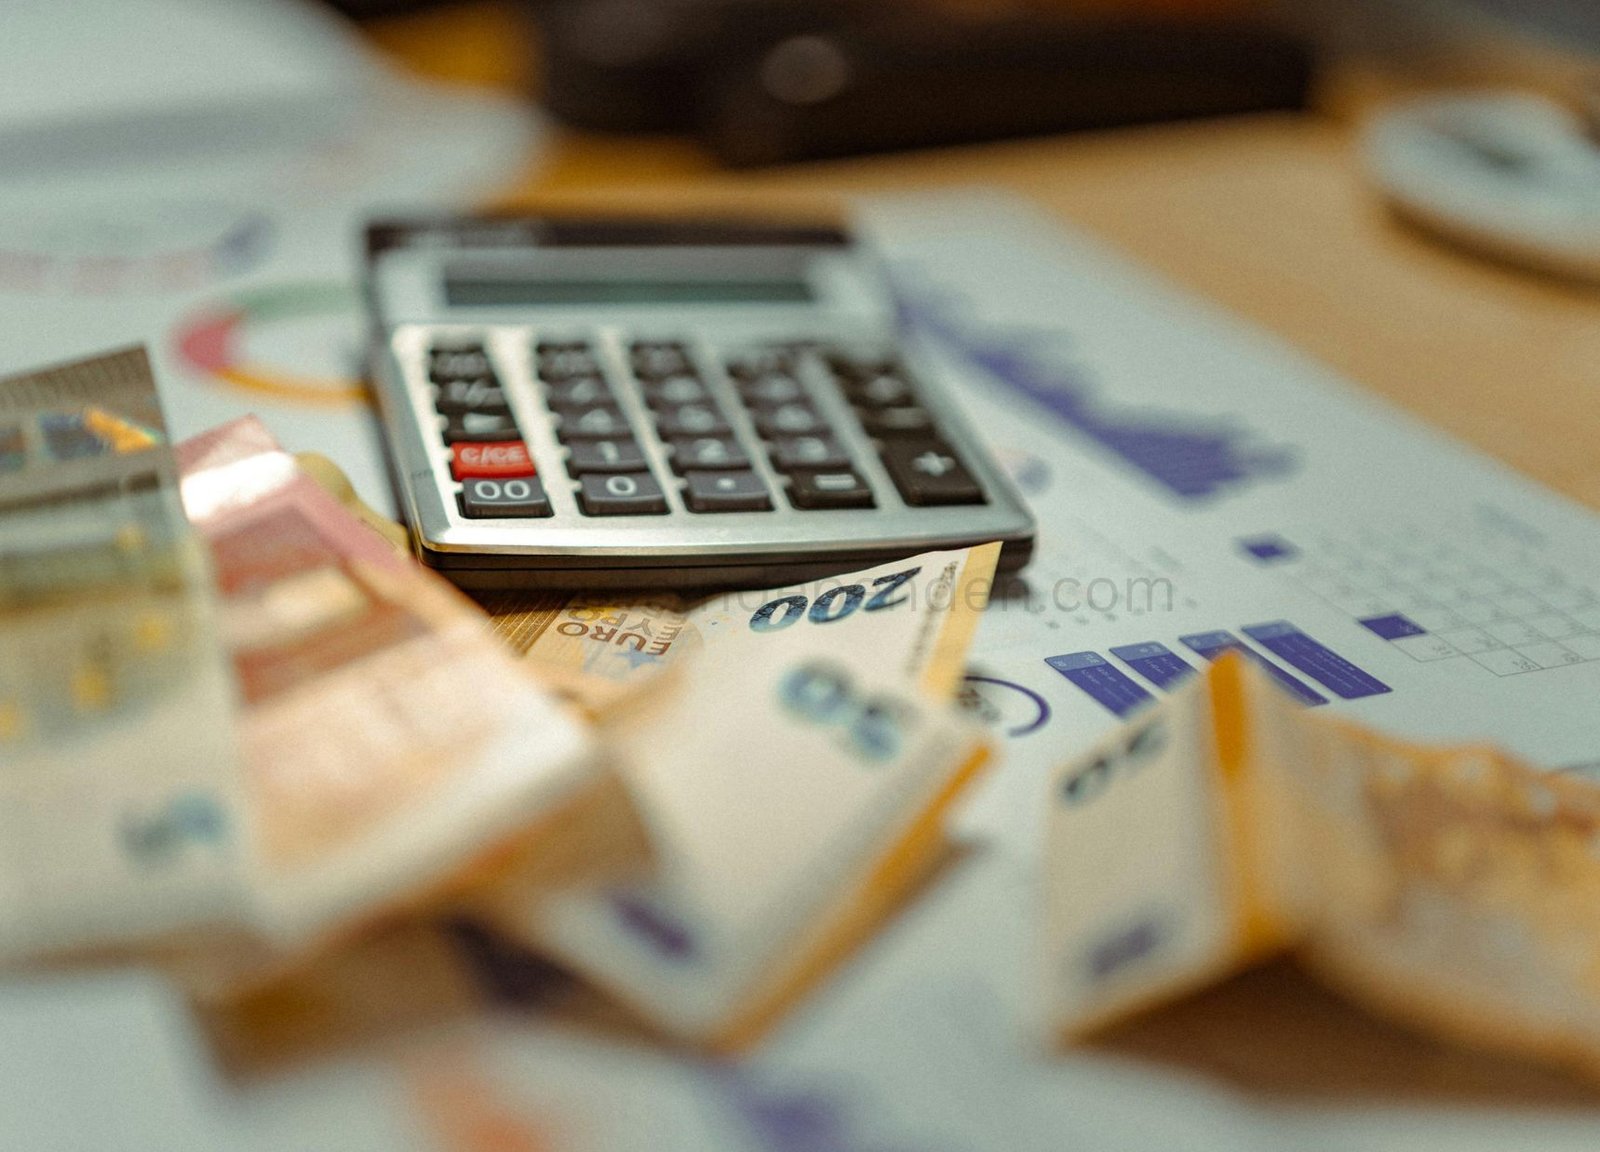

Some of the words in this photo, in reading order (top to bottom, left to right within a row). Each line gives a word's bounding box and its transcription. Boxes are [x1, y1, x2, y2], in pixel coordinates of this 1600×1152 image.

[474, 480, 530, 499] 00
[606, 475, 637, 496] 0
[749, 566, 922, 632] 200
[556, 622, 672, 656] EURO
